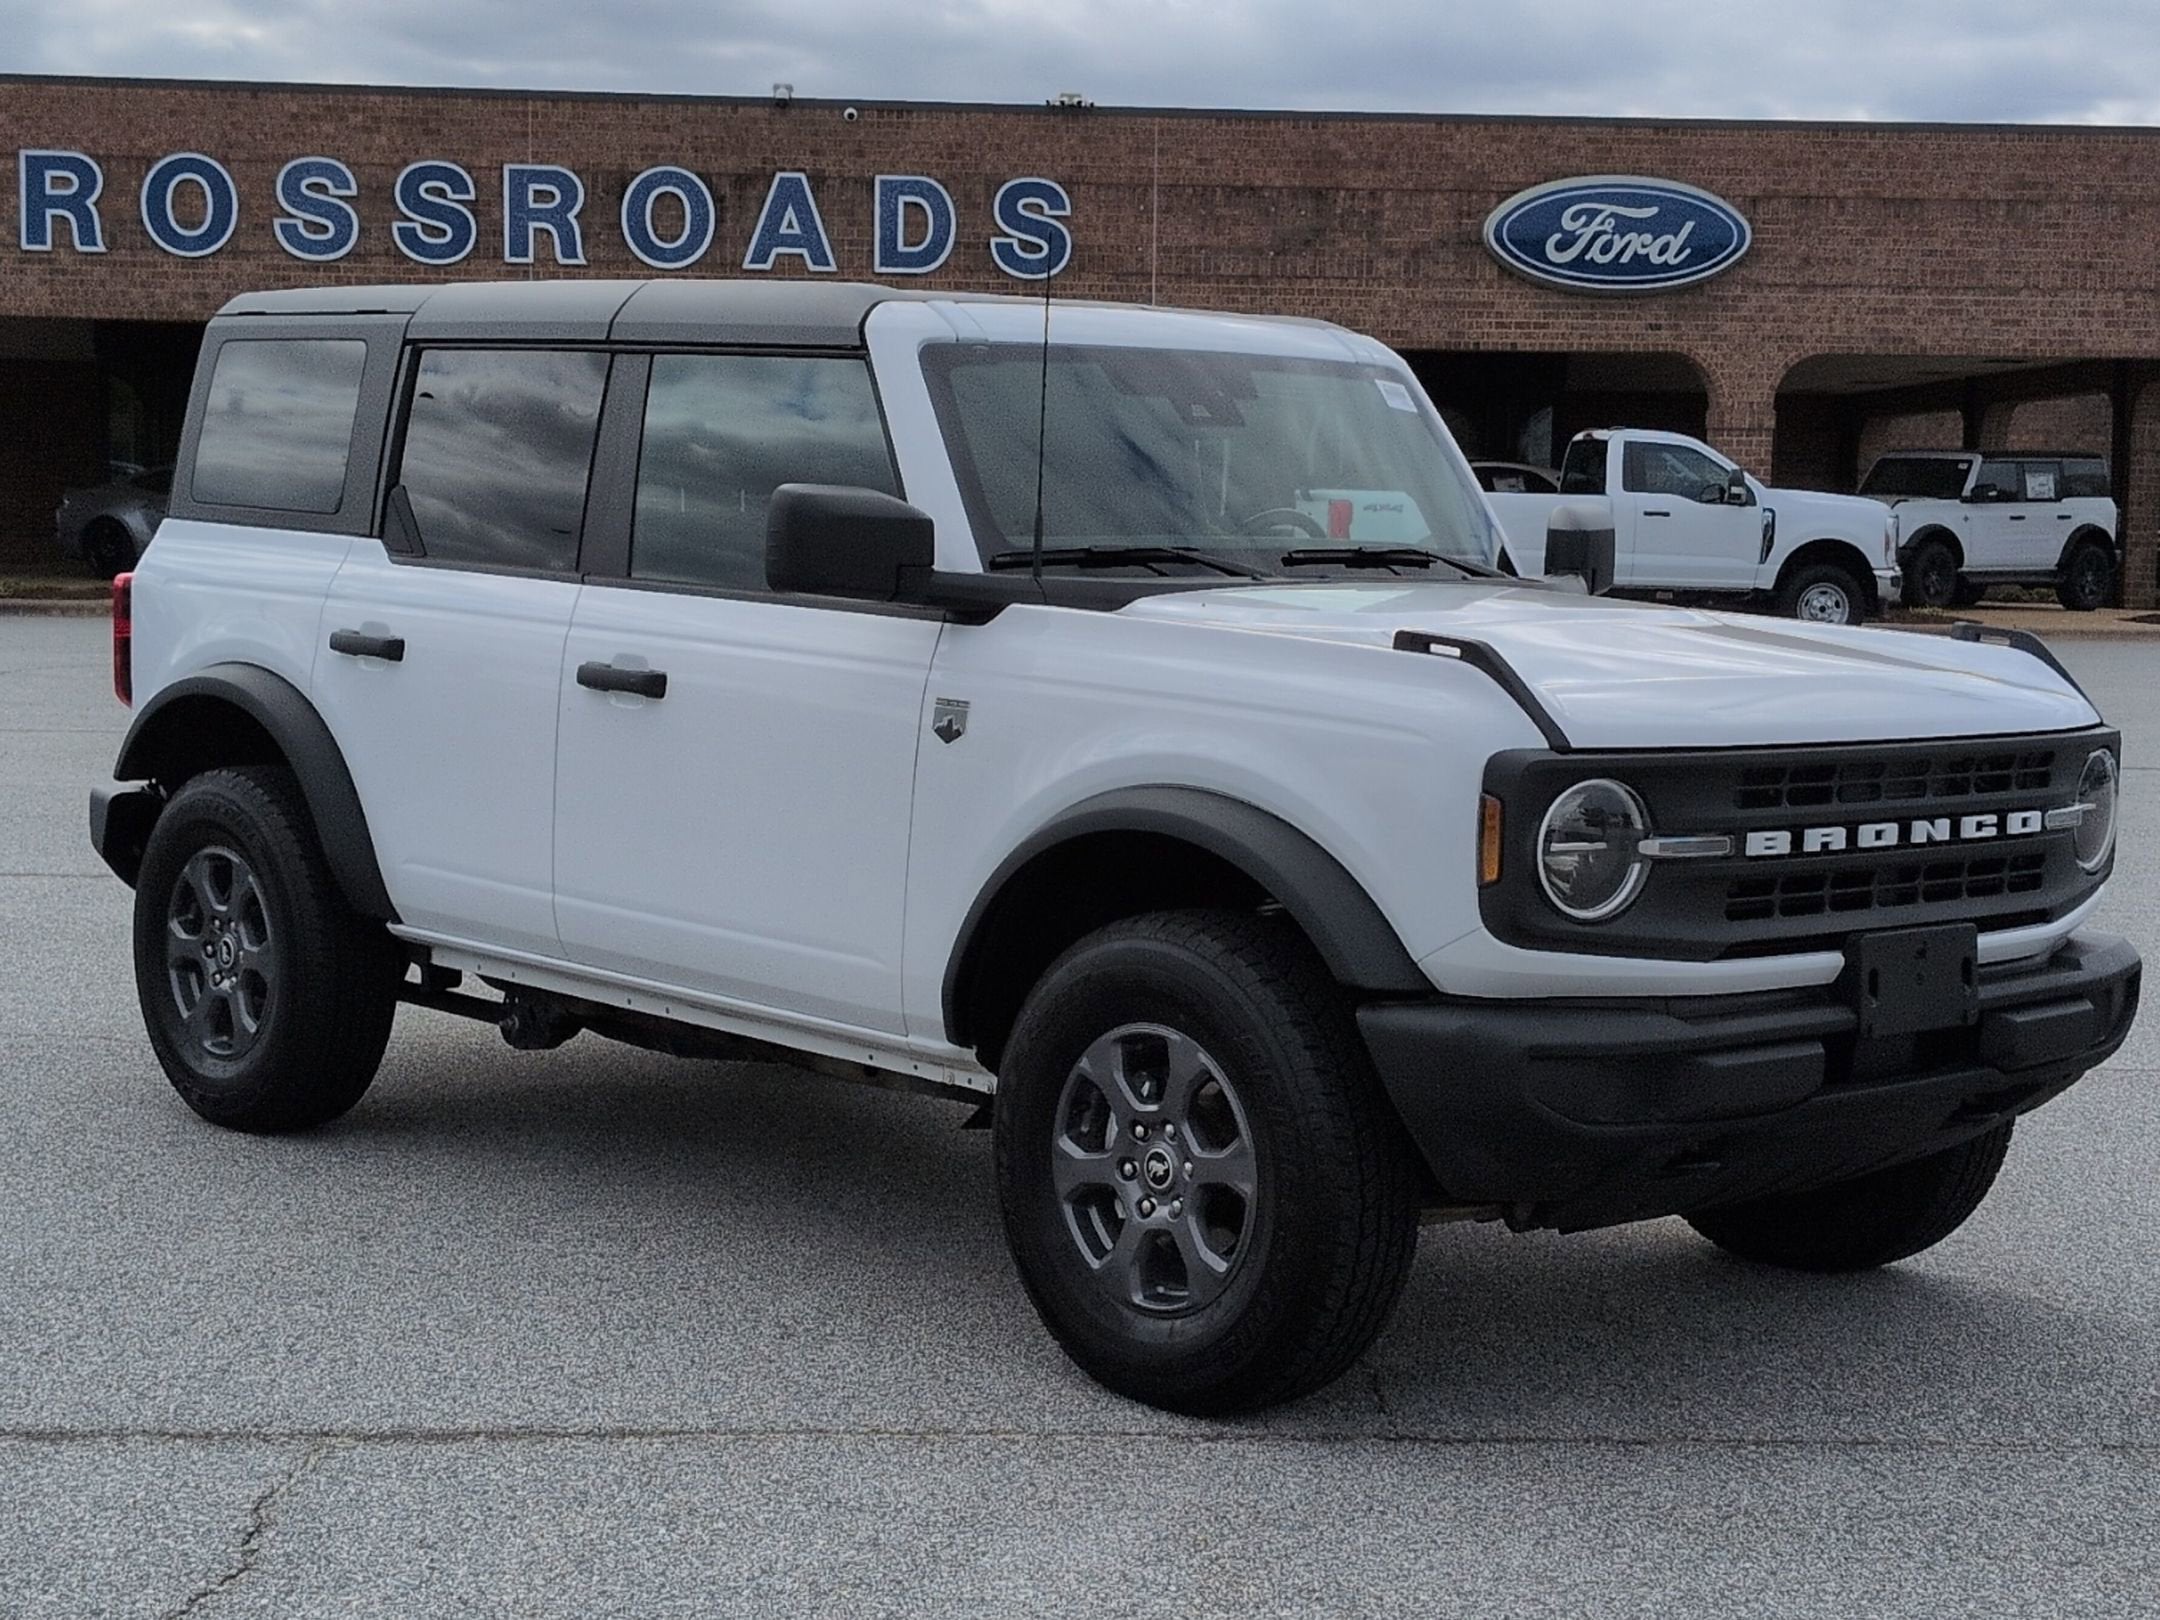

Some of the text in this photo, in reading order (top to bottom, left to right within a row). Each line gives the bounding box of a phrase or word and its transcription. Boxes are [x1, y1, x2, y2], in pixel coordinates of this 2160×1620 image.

[18, 149, 1073, 279] ROSSROADS
[1545, 203, 1696, 265] Ford
[1745, 811, 2042, 856] BRONCO
